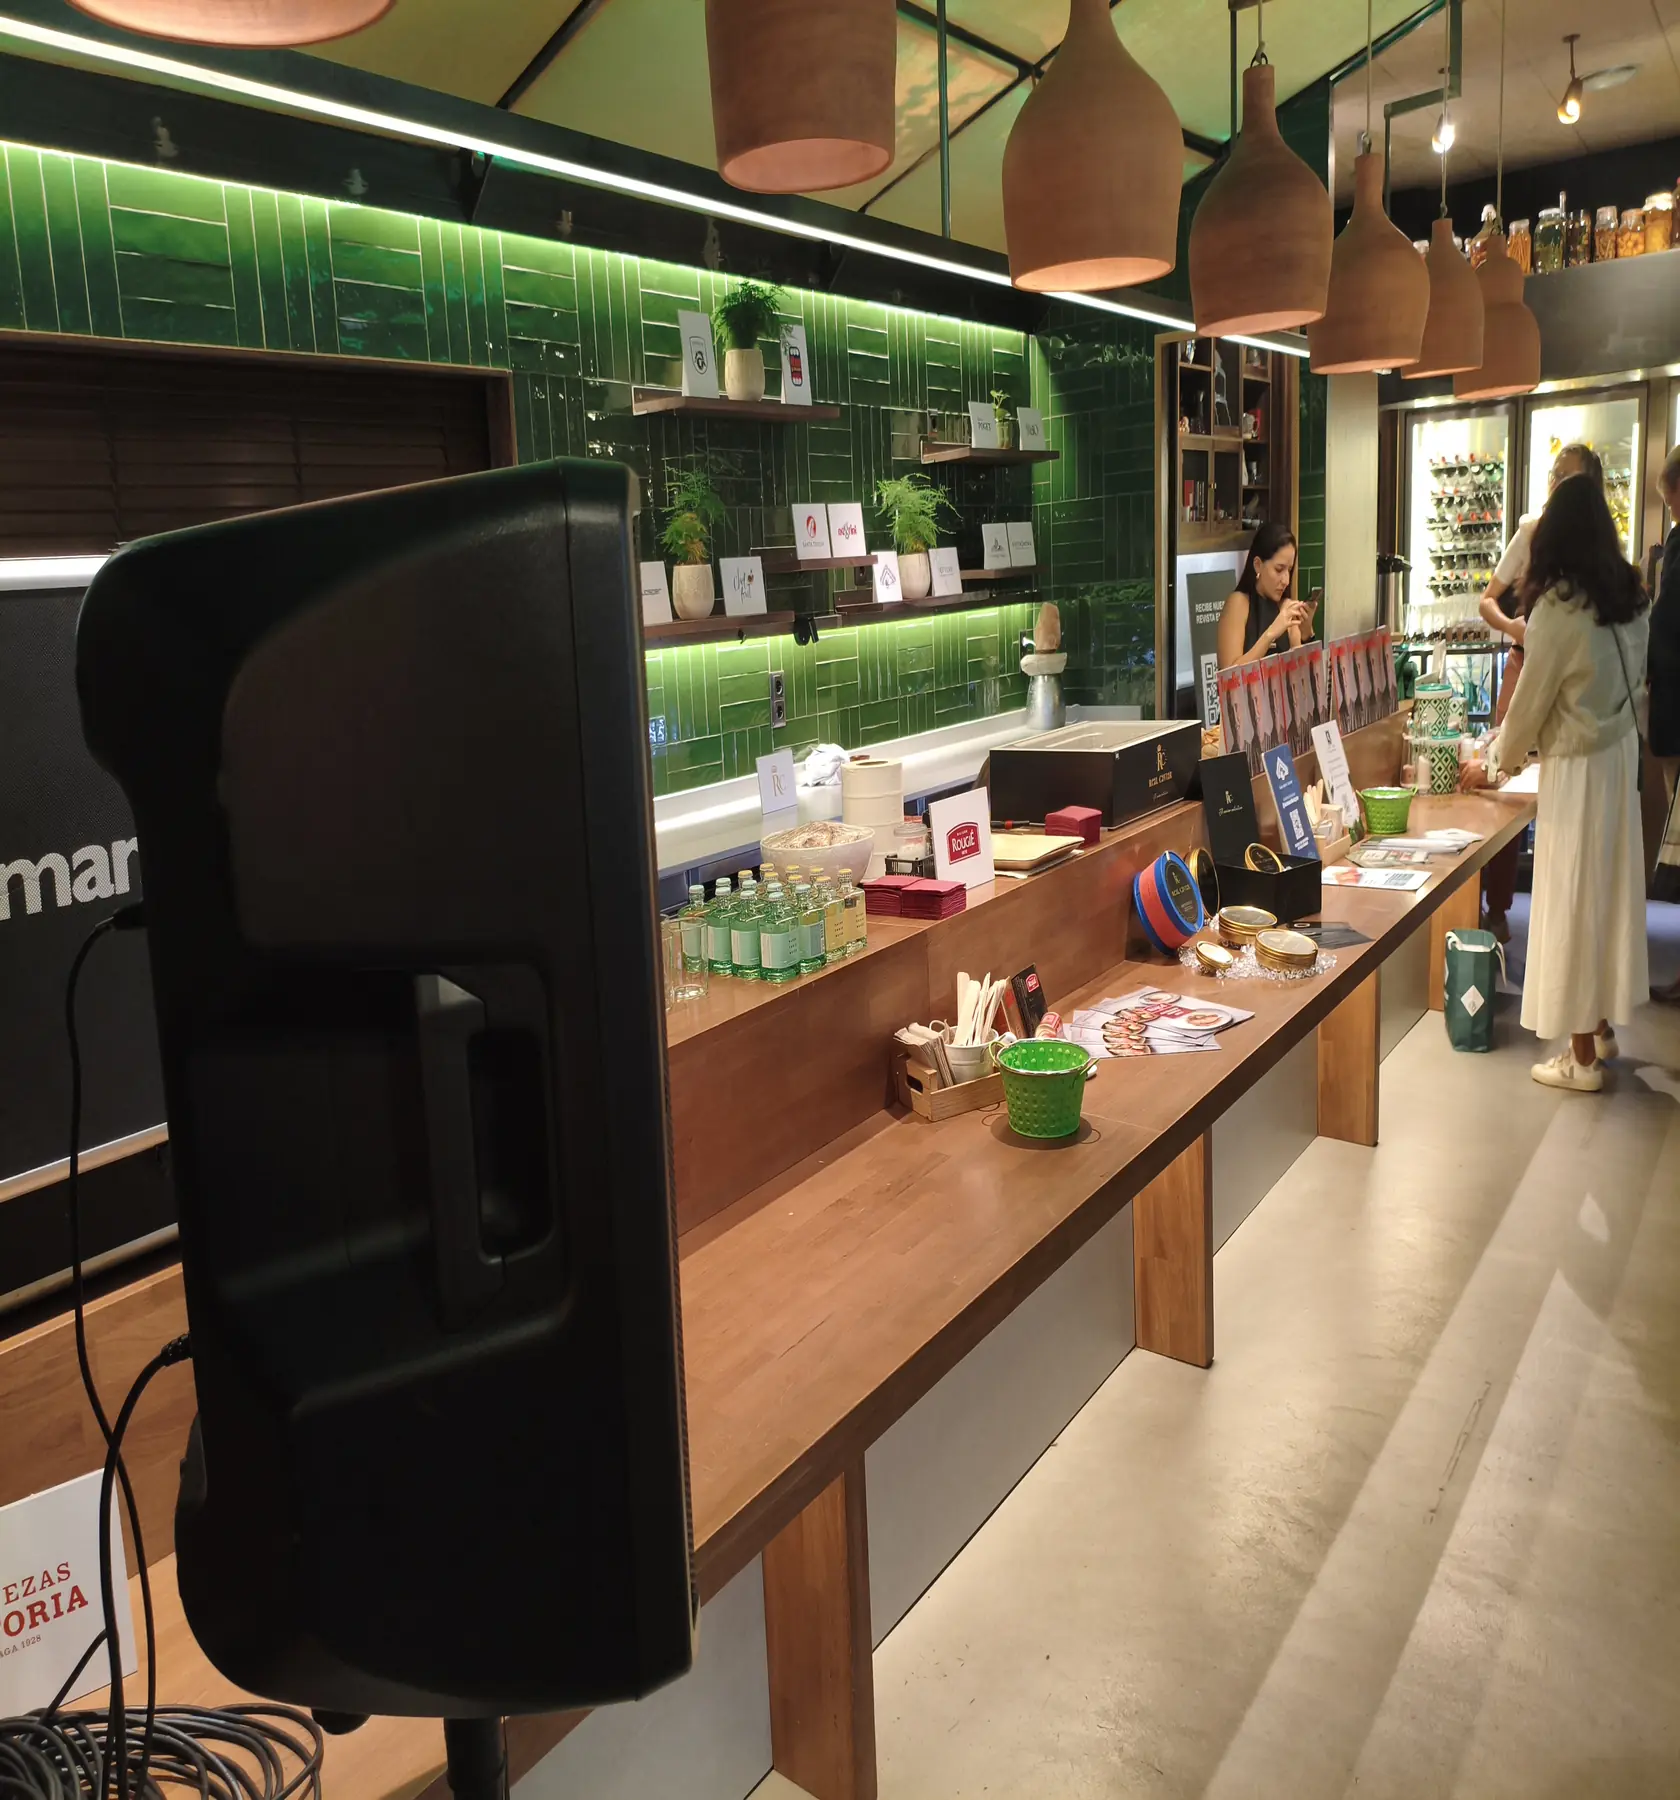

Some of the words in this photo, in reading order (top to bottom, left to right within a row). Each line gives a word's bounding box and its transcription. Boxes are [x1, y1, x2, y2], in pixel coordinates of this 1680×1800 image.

[1195, 602, 1213, 613] RECIBE
[1196, 613, 1215, 624] REVISTA
[2, 1561, 71, 1606] EZAS
[0, 1584, 89, 1637] ORIA
